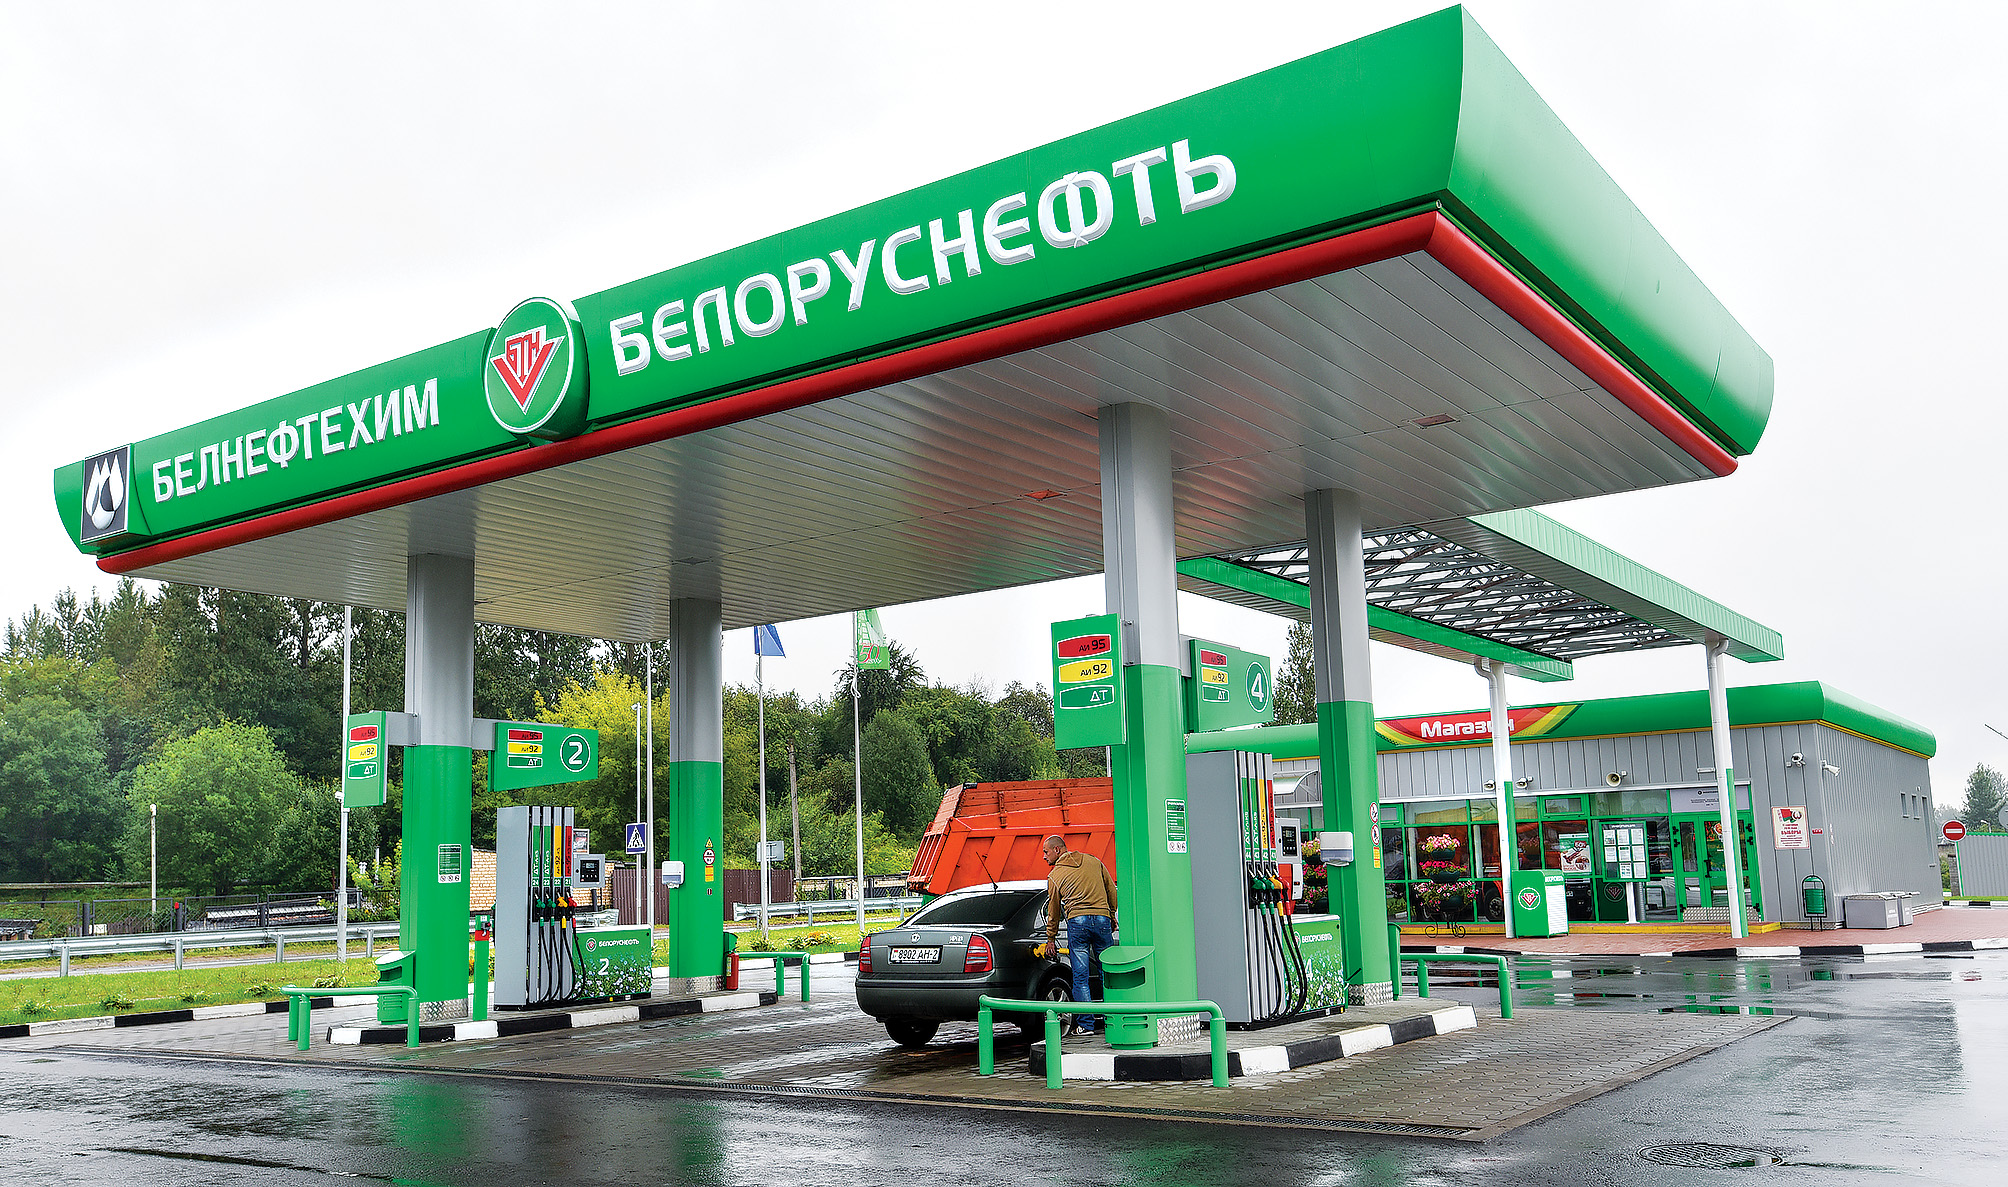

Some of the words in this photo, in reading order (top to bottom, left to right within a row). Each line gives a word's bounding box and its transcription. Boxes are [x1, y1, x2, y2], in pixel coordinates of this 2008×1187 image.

[610, 138, 1238, 377] БЕЛОРУСНЕФТЬ
[152, 377, 440, 503] БЕЛНЕФТЕХИМ
[1079, 644, 1090, 652] АИ
[1091, 638, 1106, 650] 95
[858, 643, 880, 664] 50
[1080, 668, 1092, 676] АИ
[1092, 663, 1108, 675] 92
[1251, 672, 1265, 703] 4
[1090, 689, 1109, 702] ДТ
[367, 728, 376, 737] 95
[529, 731, 539, 740] 95
[366, 747, 375, 756] 92
[528, 745, 539, 753] 92
[568, 741, 583, 765] 2
[527, 758, 538, 766] ДТ
[363, 765, 375, 775] ДТ
[597, 958, 610, 976] 2
